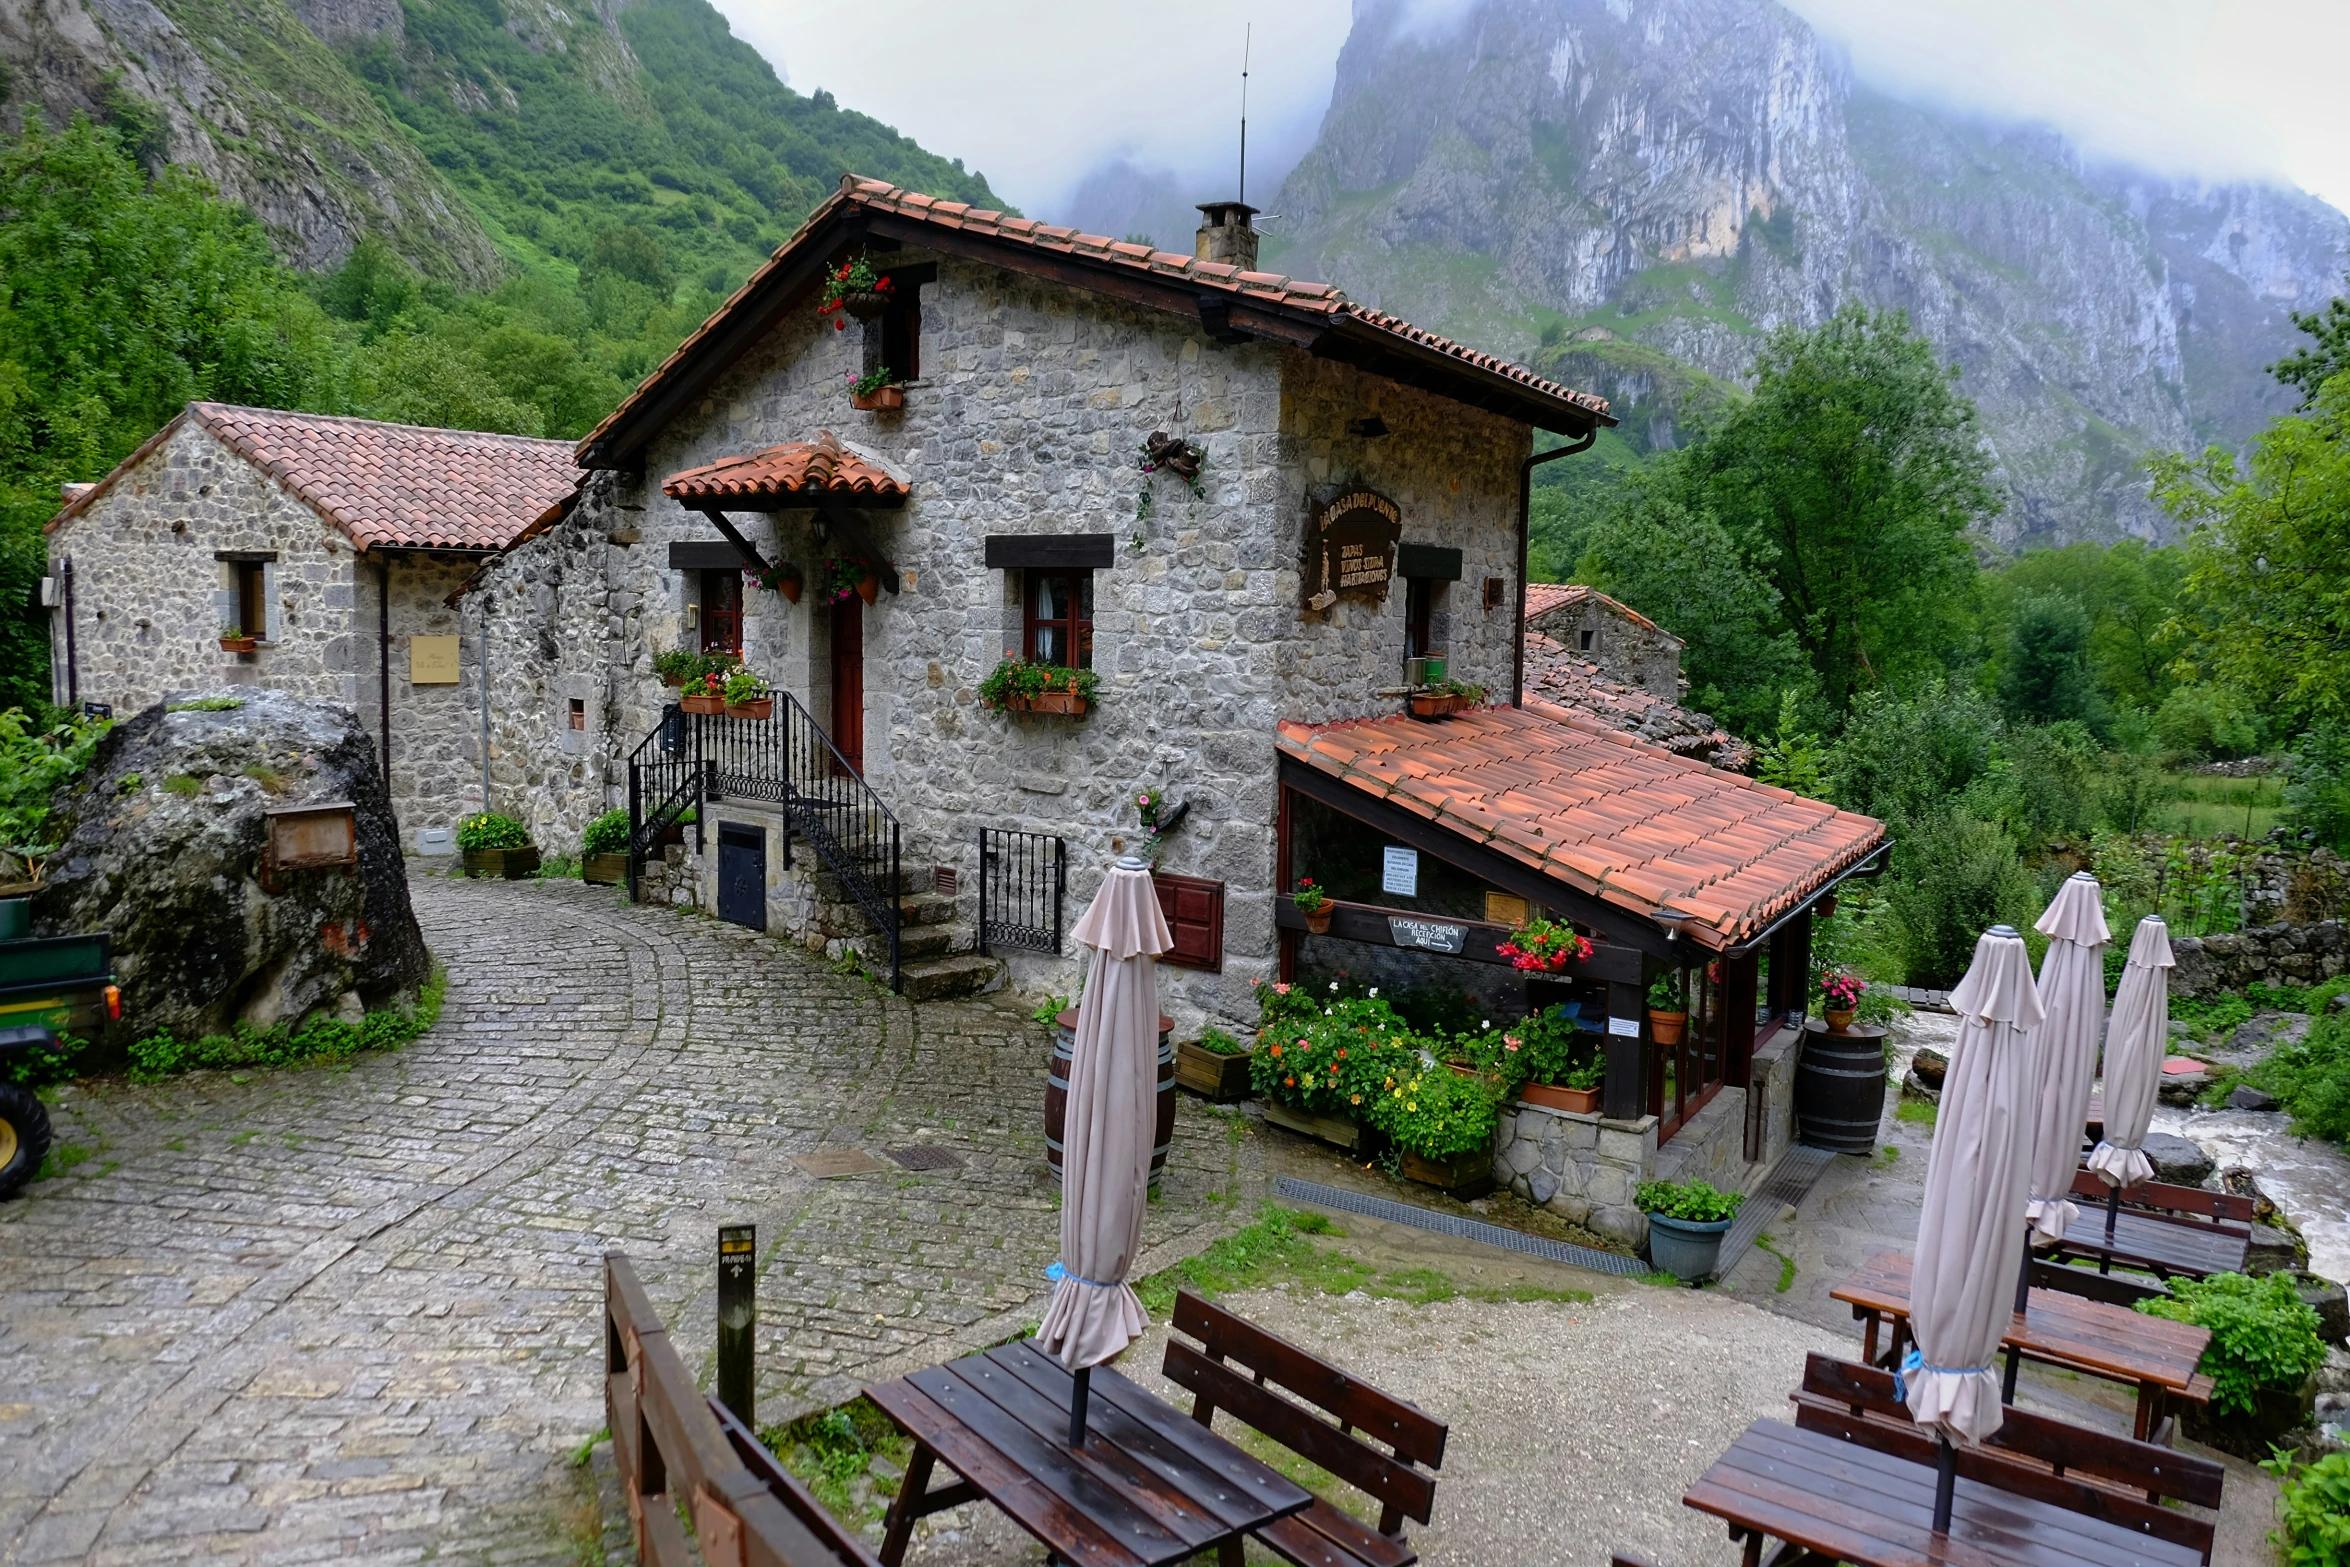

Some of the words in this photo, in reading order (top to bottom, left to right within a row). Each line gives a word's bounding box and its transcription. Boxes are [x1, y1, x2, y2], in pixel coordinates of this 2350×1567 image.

[1319, 511, 1331, 532] LA
[1330, 495, 1352, 522] CASA
[1341, 558, 1362, 573] VINOS
[1340, 568, 1388, 588] HABITACIONES
[1393, 919, 1402, 928] LA
[1402, 921, 1418, 930] CASA
[1430, 924, 1459, 937] CHIFLÓN
